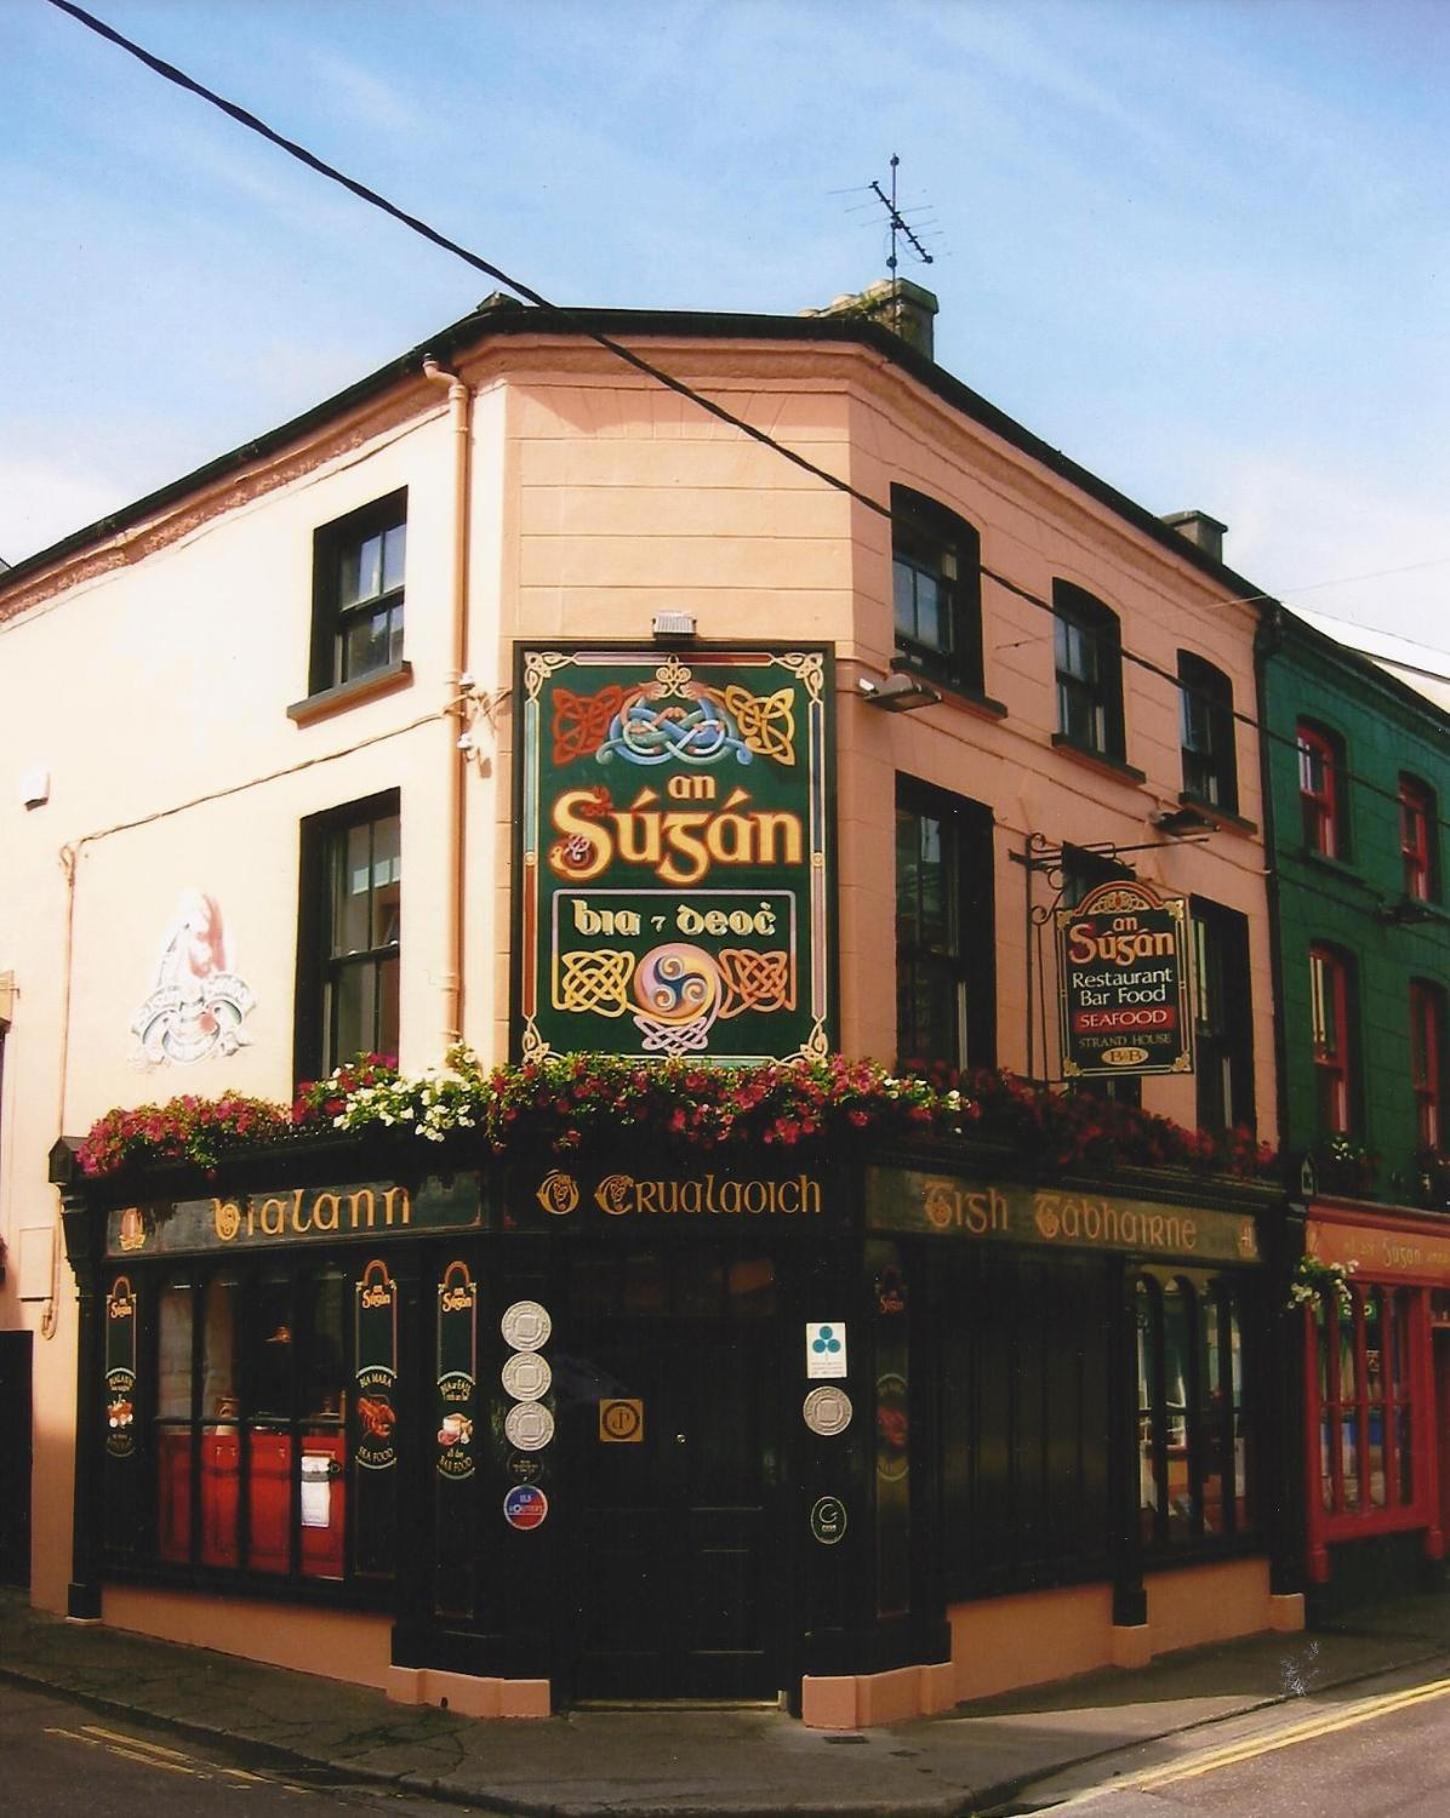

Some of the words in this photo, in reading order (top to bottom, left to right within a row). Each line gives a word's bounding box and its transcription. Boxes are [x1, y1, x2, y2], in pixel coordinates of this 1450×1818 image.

[667, 775, 716, 799] an
[550, 785, 803, 883] Súgán
[571, 899, 641, 936] bia
[1112, 916, 1138, 932] an
[1069, 923, 1175, 966] Súgán
[1072, 967, 1174, 989] Restaurant
[1081, 989, 1111, 1007] Bar
[1118, 983, 1166, 1004] Food
[1080, 1009, 1168, 1028] SEAFOOD
[1078, 1035, 1128, 1049] STRAND
[1132, 1033, 1172, 1047] HOUSE
